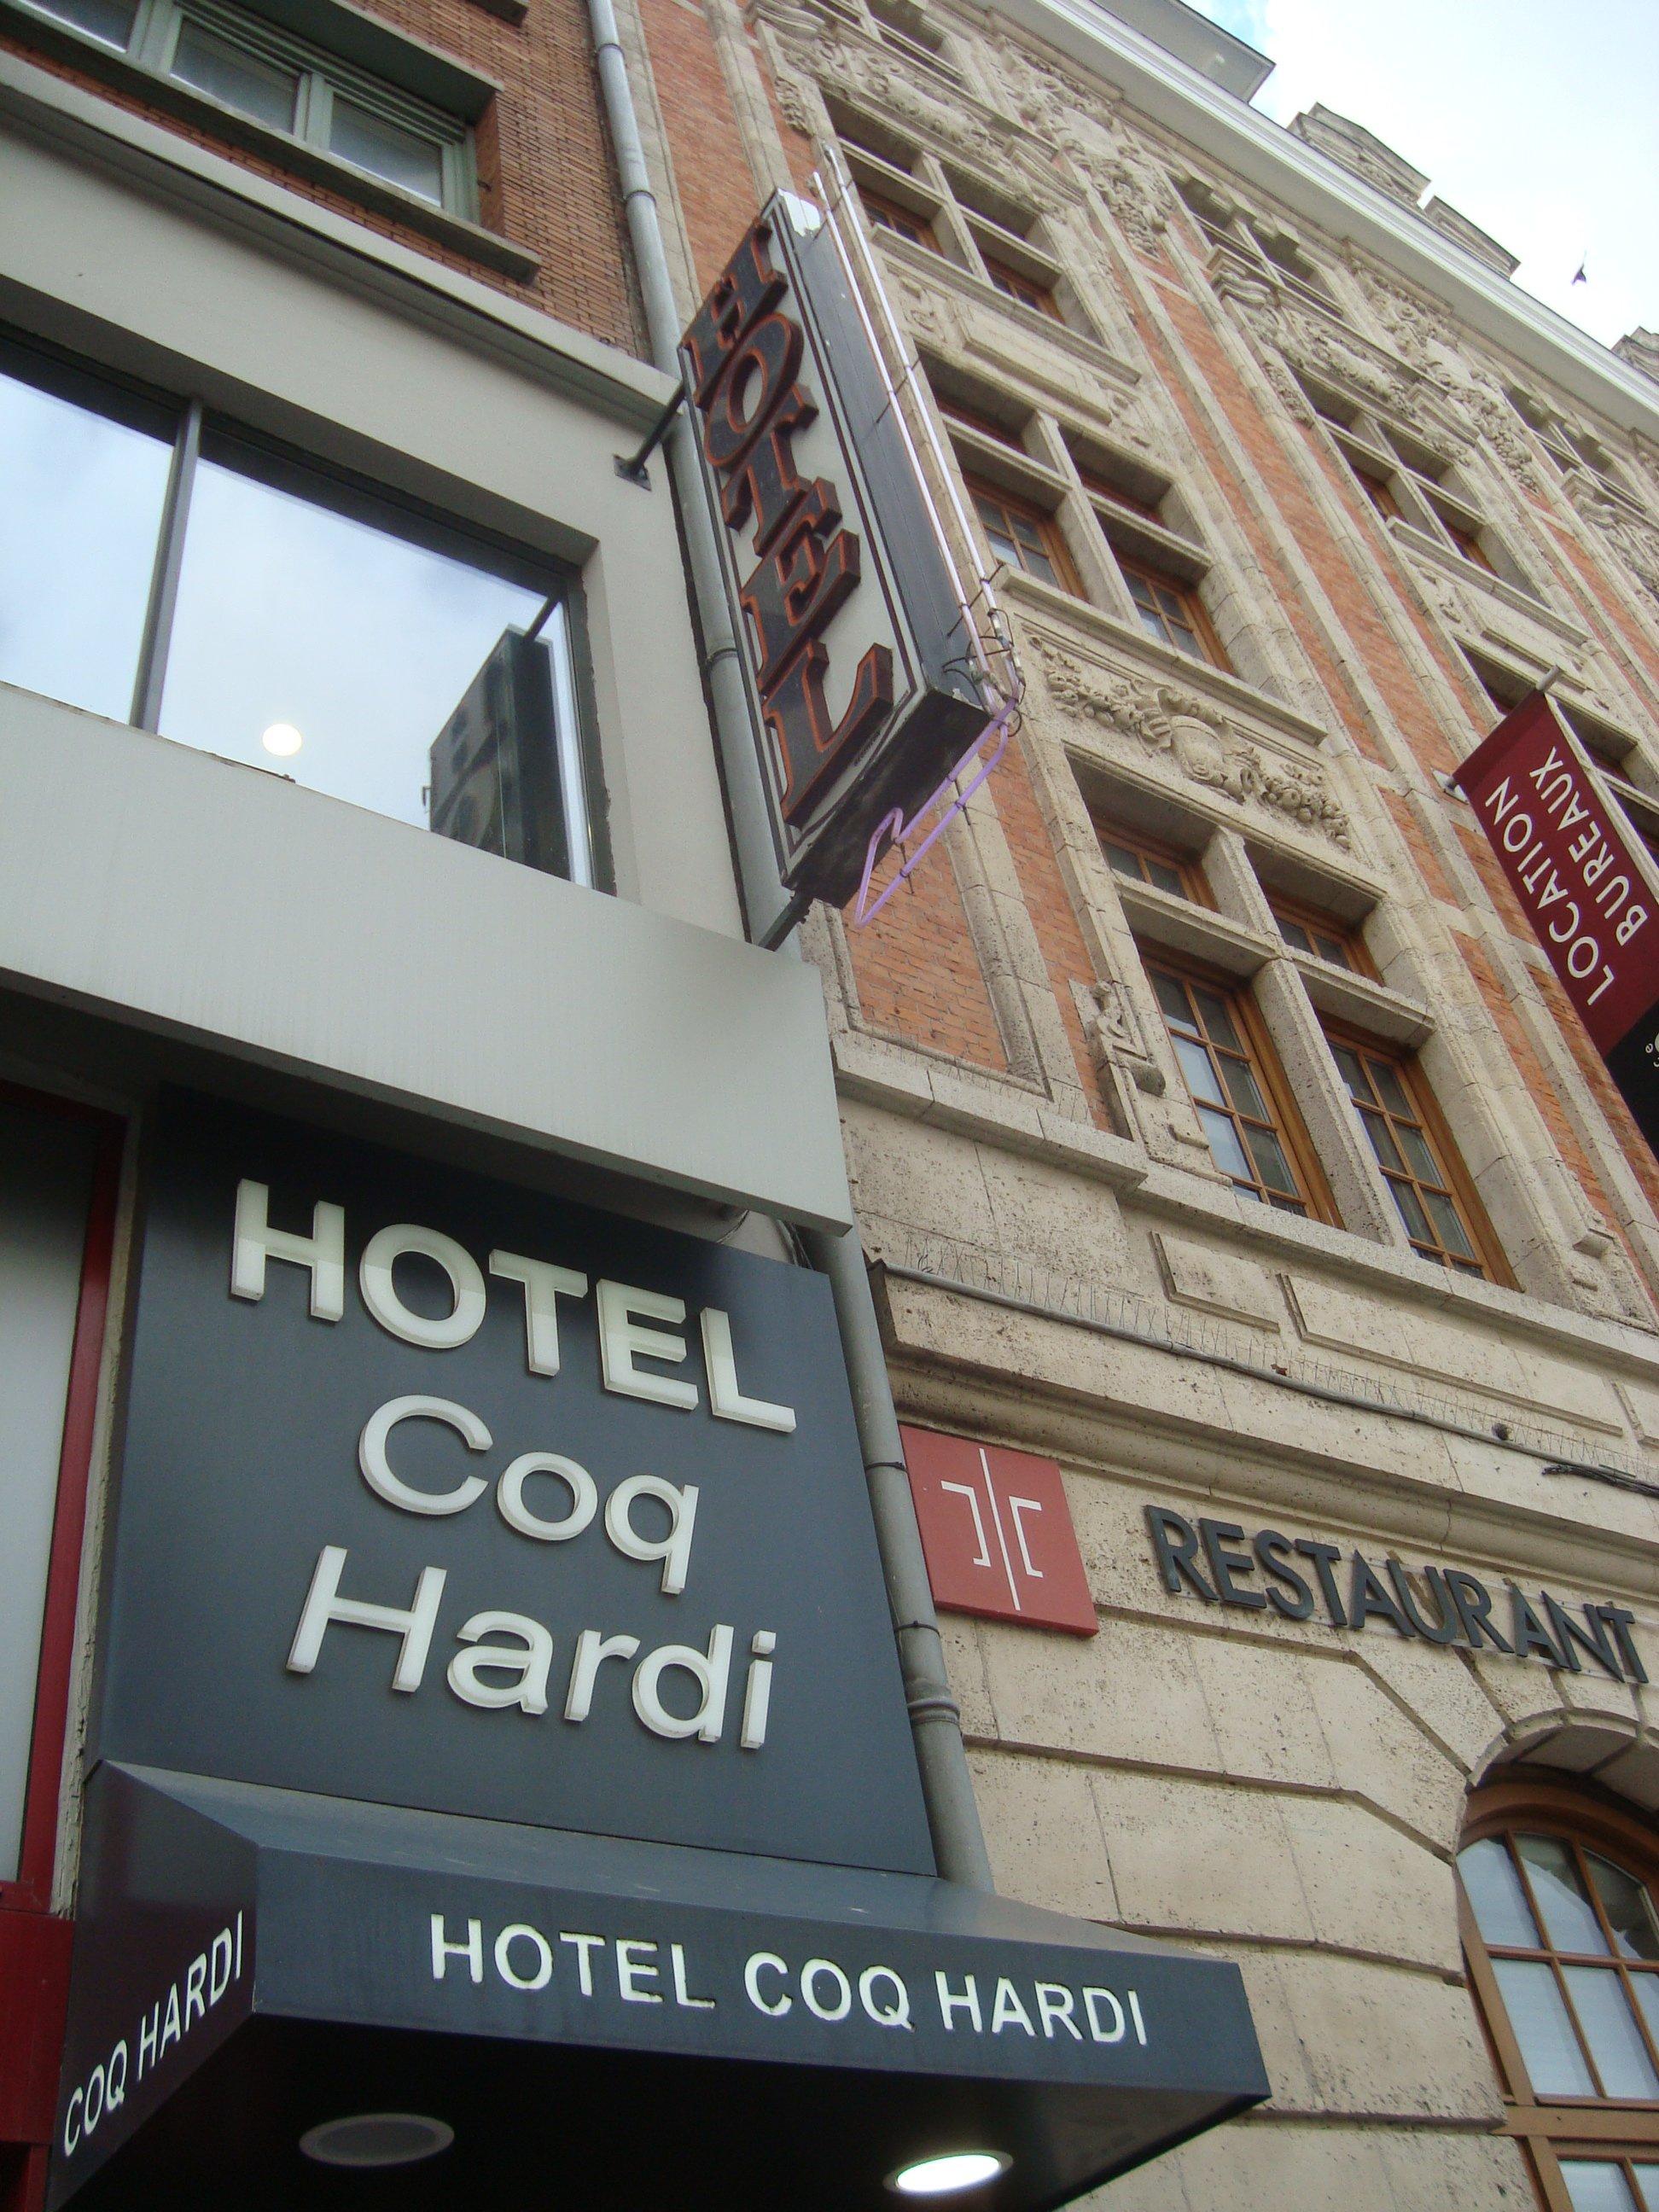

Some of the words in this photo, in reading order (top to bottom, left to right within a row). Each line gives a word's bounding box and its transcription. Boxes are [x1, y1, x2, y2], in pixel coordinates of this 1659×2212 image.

[680, 217, 894, 827] HOTEL
[1485, 776, 1616, 1005] LOCATION
[1528, 746, 1649, 946] BUREAUX
[230, 1178, 796, 1434] HOTEL
[358, 1394, 700, 1595] Coq
[1144, 1505, 1650, 1684] RESTAURANT
[286, 1545, 777, 1749] Hardi
[64, 2039, 129, 2157] COQ
[137, 1908, 244, 2082] HARDI
[429, 1912, 716, 2009] HOTEL
[743, 1952, 917, 2031] COQ
[934, 1970, 1149, 2046] HARDI
